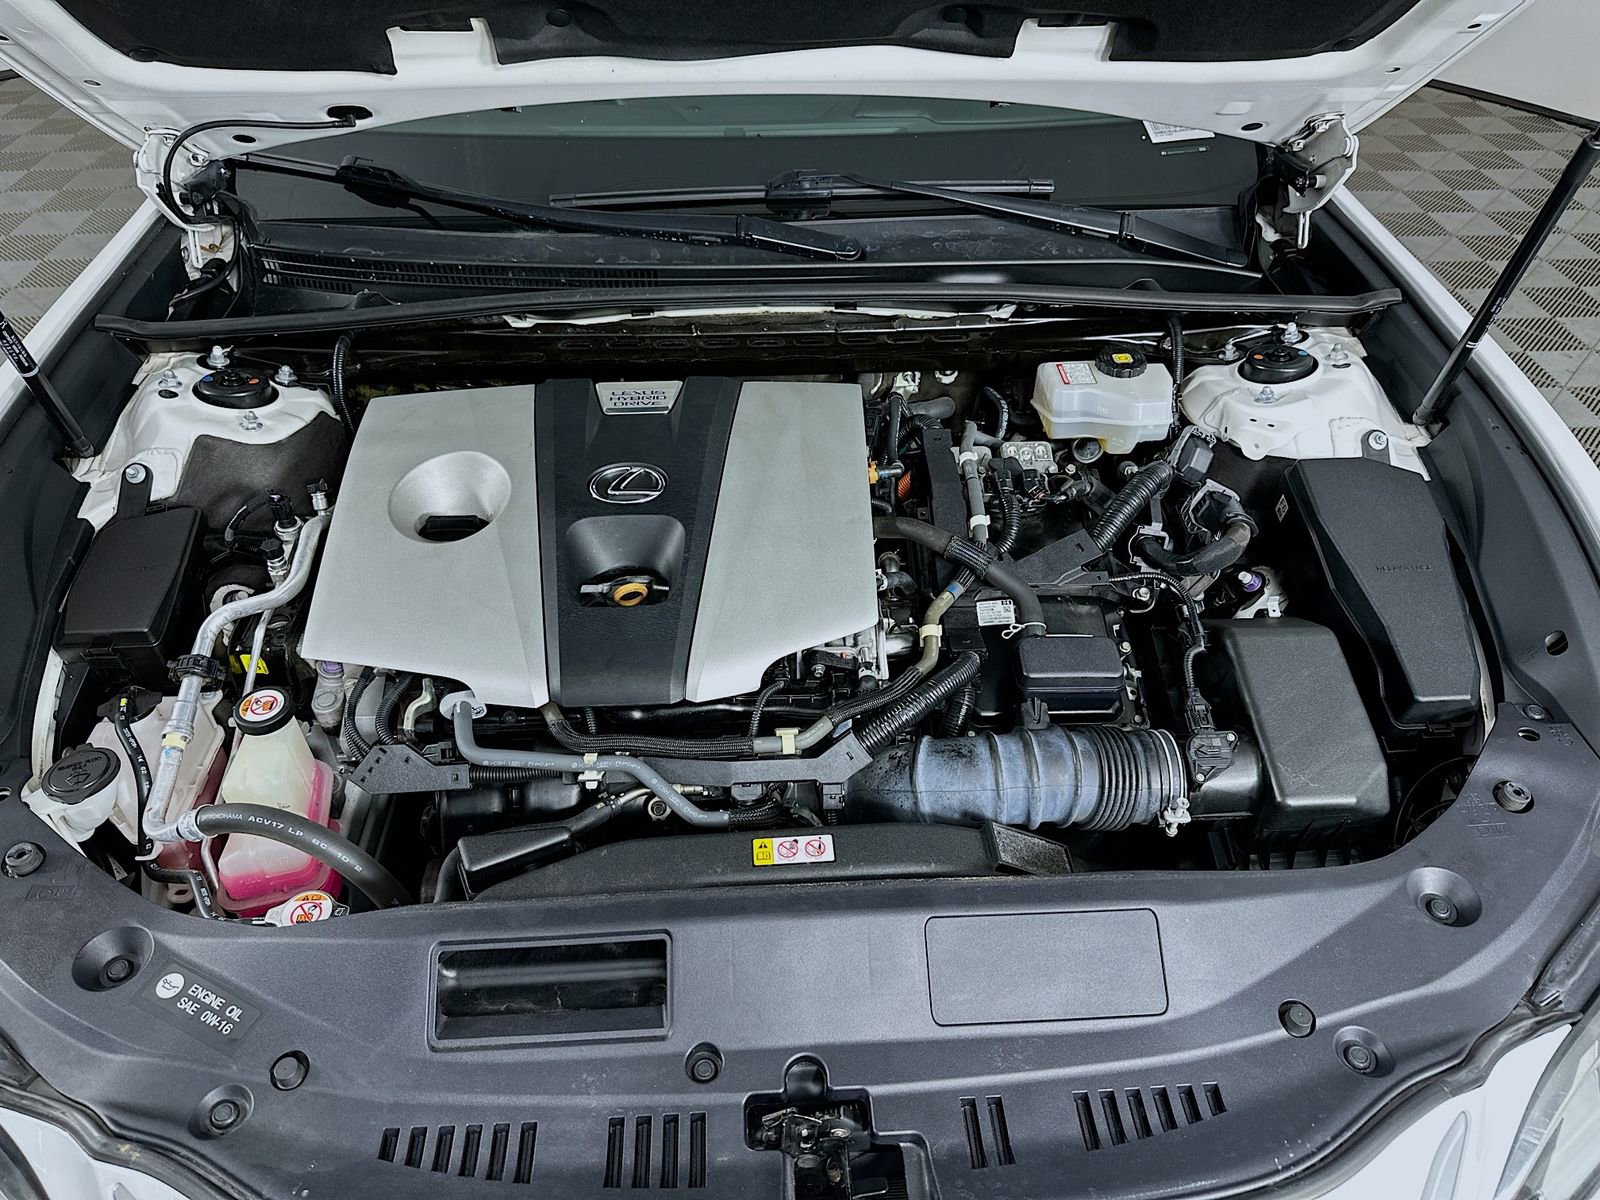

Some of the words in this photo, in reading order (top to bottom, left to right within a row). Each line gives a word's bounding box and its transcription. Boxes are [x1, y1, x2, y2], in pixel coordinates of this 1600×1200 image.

[247, 815, 284, 830] ACV17
[288, 827, 304, 838] LP
[176, 996, 201, 1016] SAE
[200, 1010, 234, 1035] 0W-16
[187, 983, 226, 1011] ENGINE
[225, 1004, 243, 1022] OIL
